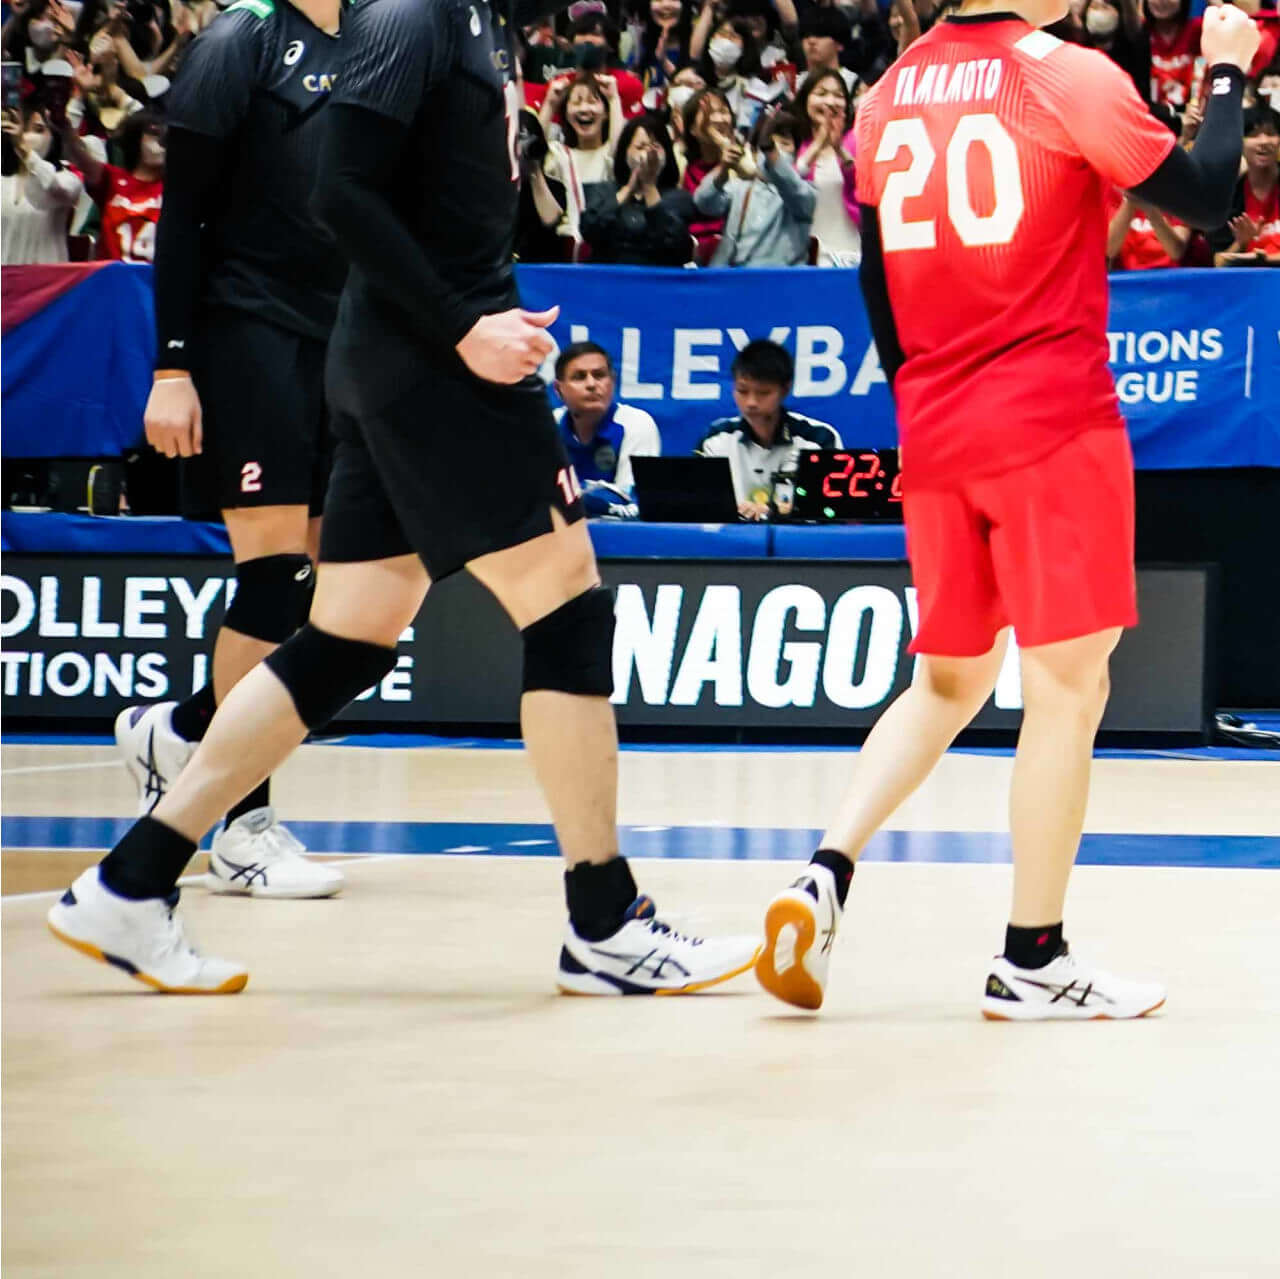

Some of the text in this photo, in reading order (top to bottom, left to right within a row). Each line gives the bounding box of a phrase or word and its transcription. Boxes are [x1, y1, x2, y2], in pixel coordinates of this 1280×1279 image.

[874, 113, 1025, 253] 20
[1108, 328, 1223, 363] TIONS
[240, 461, 263, 493] 2
